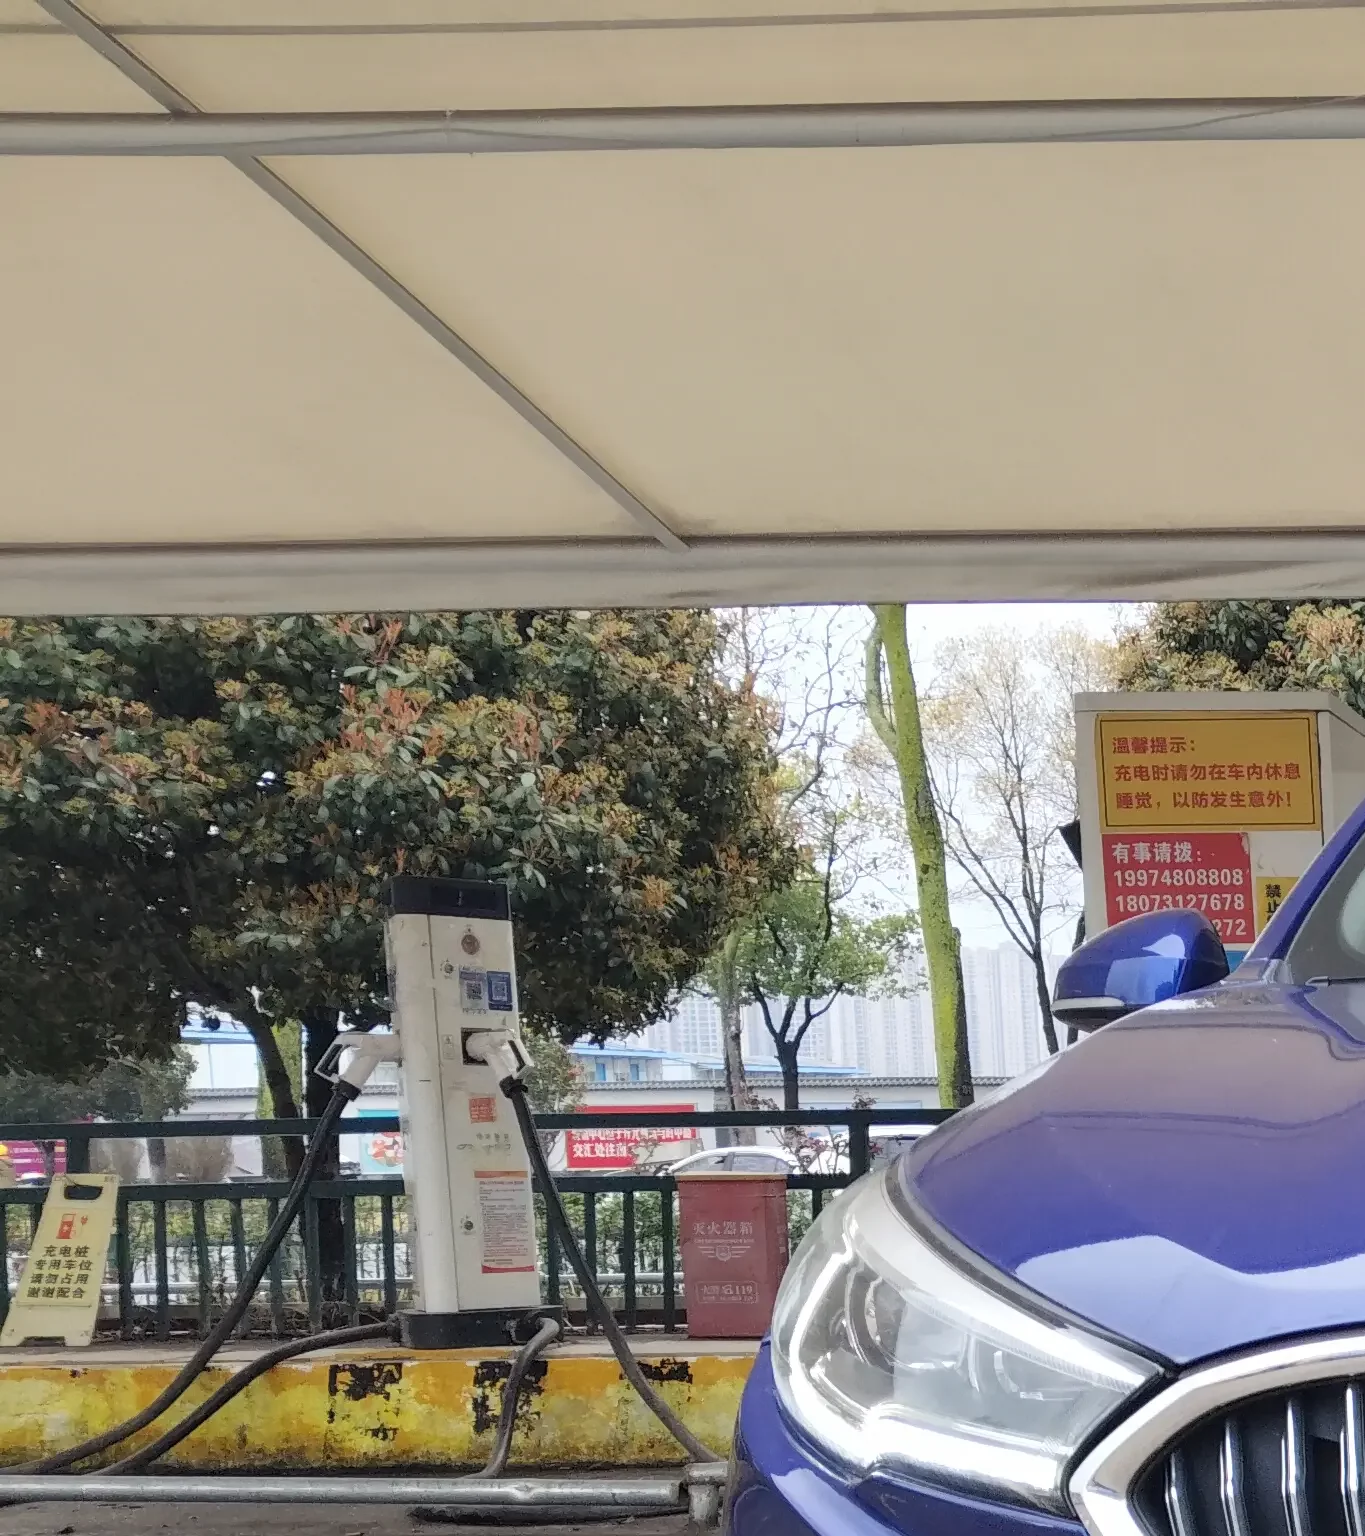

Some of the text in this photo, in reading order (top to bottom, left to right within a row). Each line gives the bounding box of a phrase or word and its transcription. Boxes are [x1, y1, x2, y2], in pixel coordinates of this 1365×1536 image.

[1112, 736, 1196, 755] 温馨提示：
[1114, 763, 1301, 782] 充电时请勿在车内休息
[1112, 842, 1202, 864] 有事请拨：
[1113, 868, 1244, 887] 19974808808
[1115, 893, 1245, 913] 18073127678
[693, 1221, 753, 1236] 灭火器箱
[43, 1245, 91, 1258] 充电桩
[34, 1259, 94, 1272] 专用车位
[30, 1273, 90, 1285] 请勿占用
[27, 1286, 87, 1299] 谢谢配合
